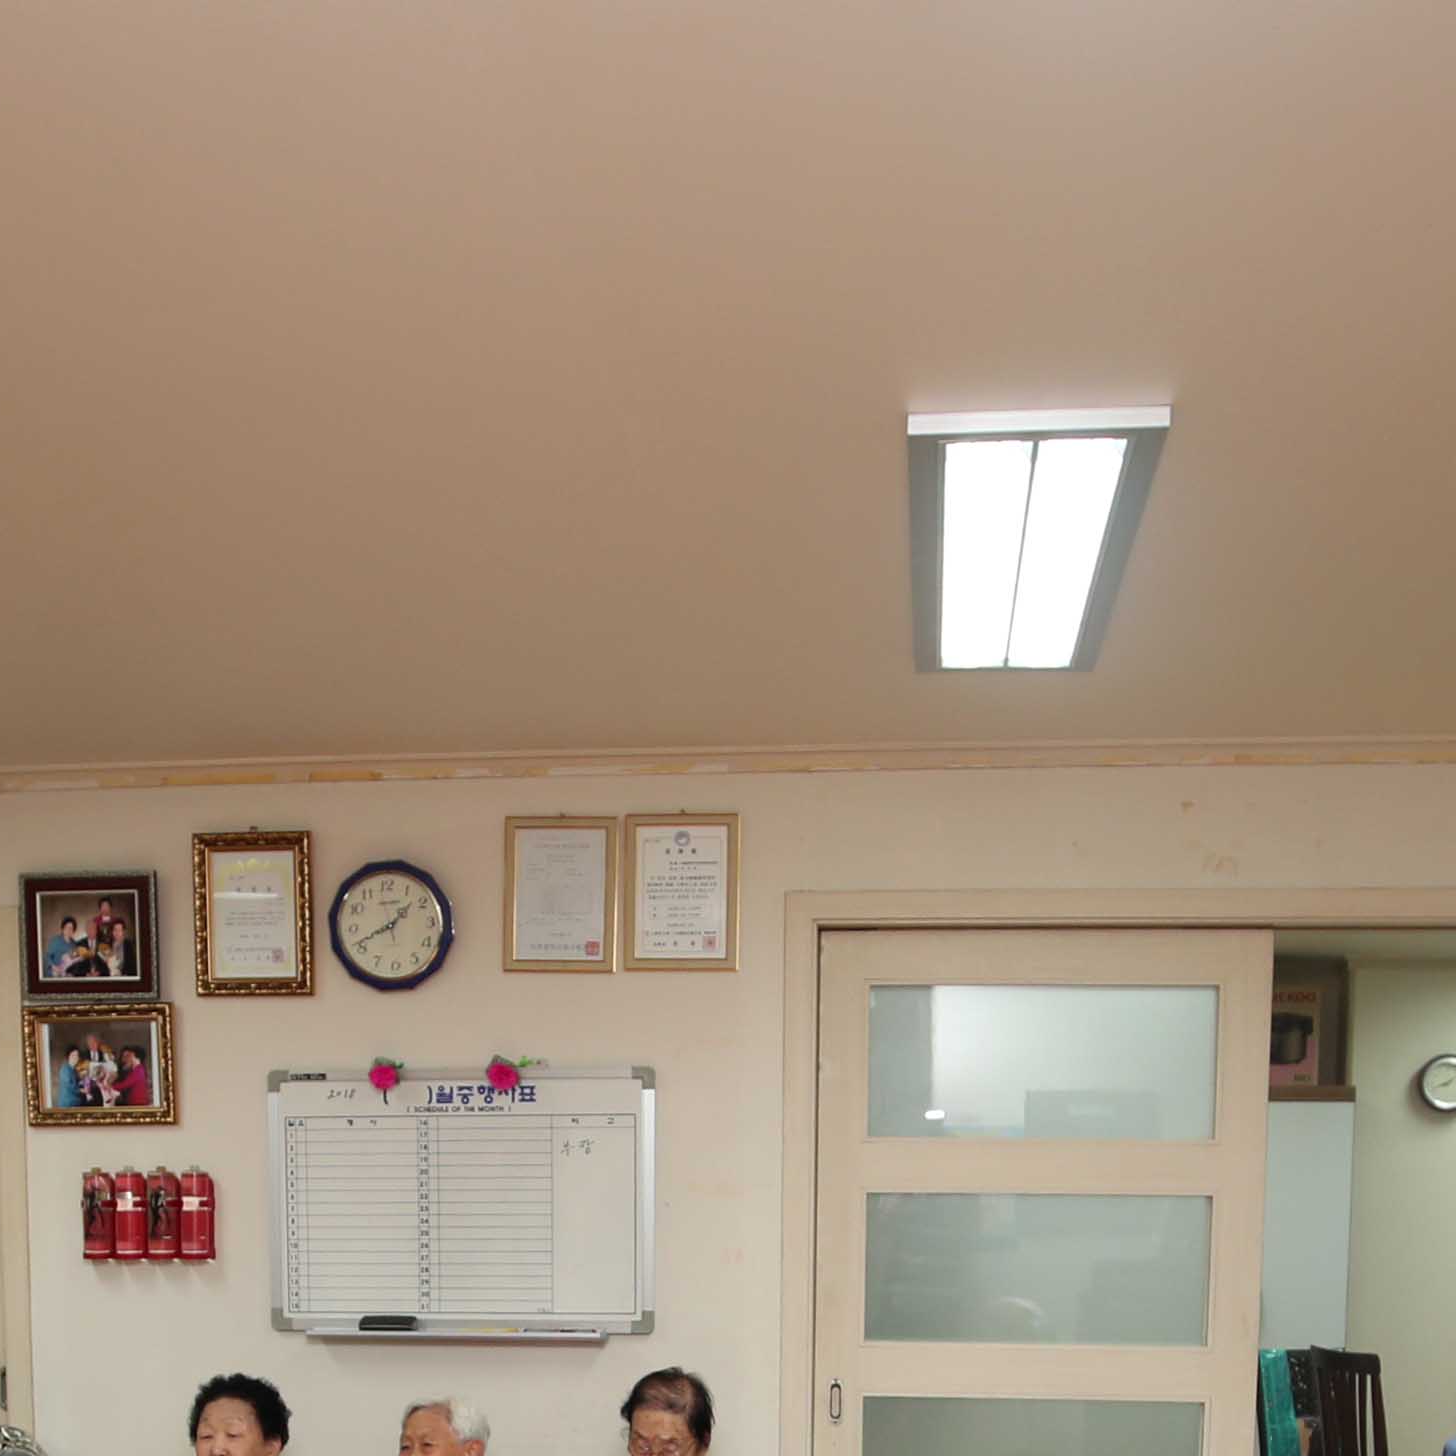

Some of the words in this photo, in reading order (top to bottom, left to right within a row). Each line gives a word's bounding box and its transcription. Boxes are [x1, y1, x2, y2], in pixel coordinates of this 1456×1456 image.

[381, 880, 394, 891] 12
[405, 885, 409, 896] 1
[363, 888, 373, 900] 11
[351, 903, 364, 915] 10
[418, 897, 427, 909] 2
[426, 916, 435, 928] 3
[422, 936, 432, 947] 4
[373, 954, 383, 967] 7
[411, 952, 419, 964] 5
